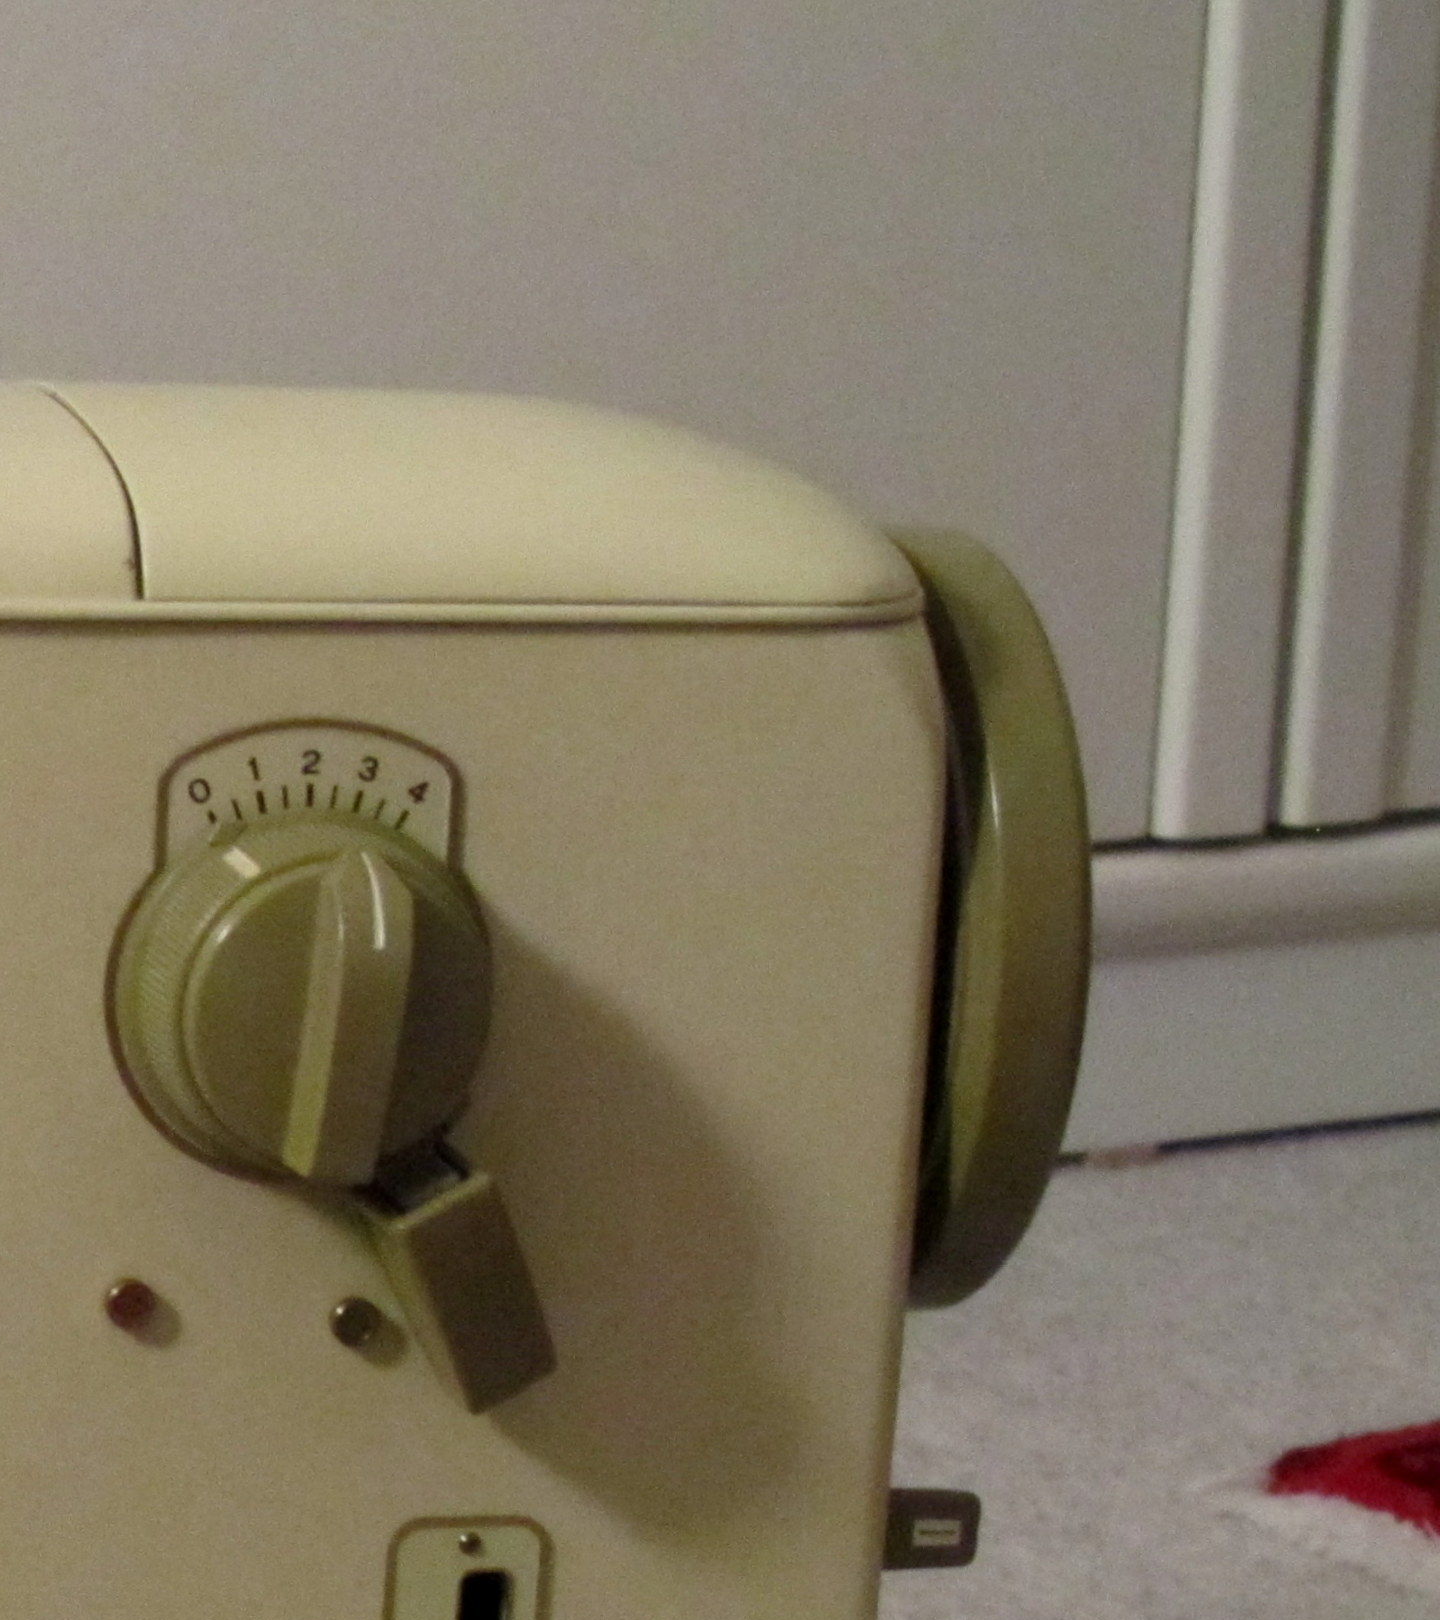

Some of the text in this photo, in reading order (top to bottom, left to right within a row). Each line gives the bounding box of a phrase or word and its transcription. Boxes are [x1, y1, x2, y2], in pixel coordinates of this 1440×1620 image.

[187, 750, 430, 804] 0 1 2 3 4
